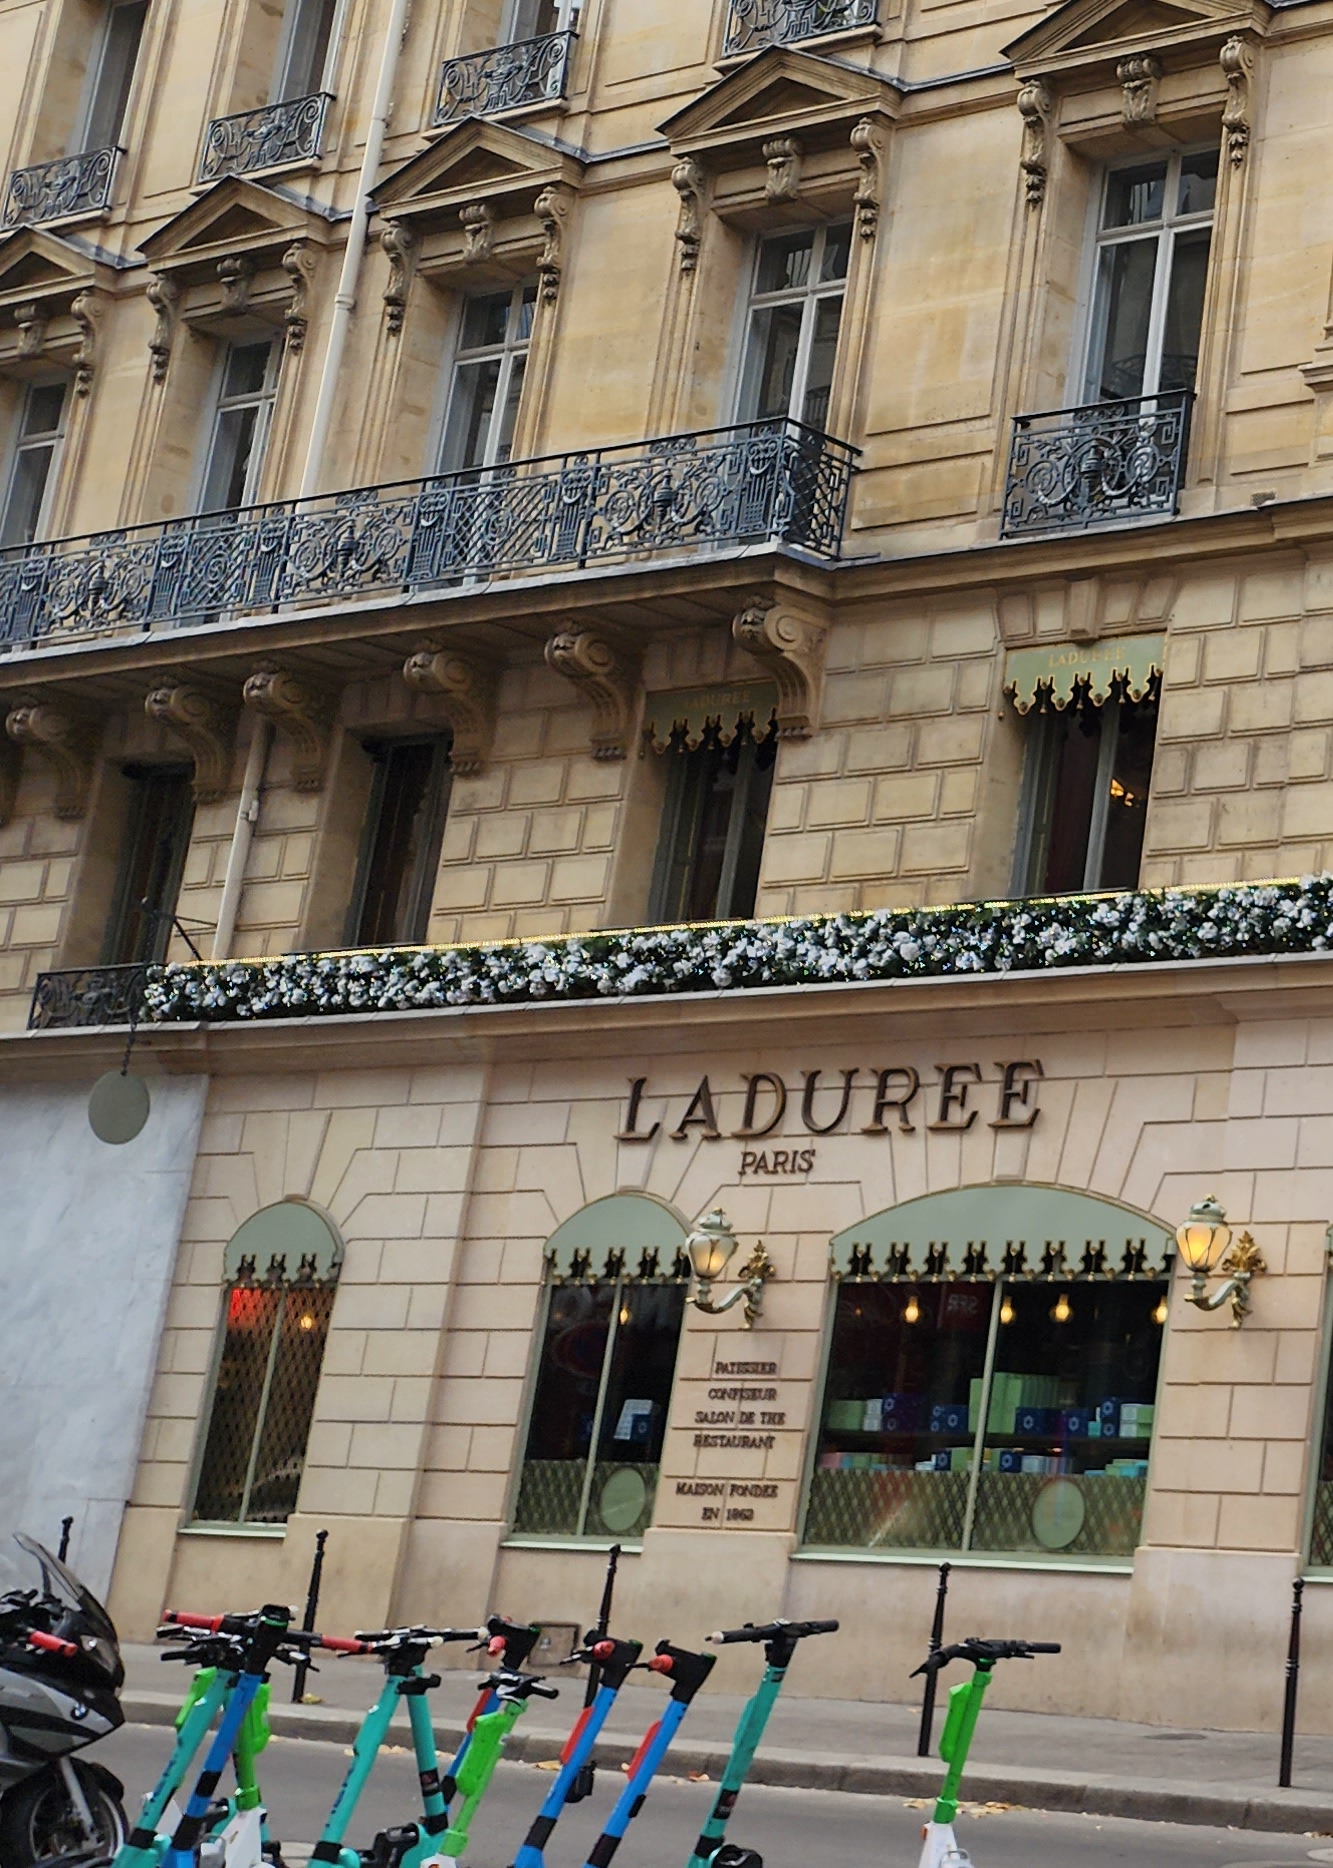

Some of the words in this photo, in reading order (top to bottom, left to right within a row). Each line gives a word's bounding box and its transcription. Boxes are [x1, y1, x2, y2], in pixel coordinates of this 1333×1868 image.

[613, 1059, 1045, 1142] LADUREE
[738, 1149, 816, 1175] PARIS
[715, 1362, 777, 1374] PATISSIER
[708, 1388, 777, 1400] CONFISEUR
[694, 1411, 735, 1424] SALON
[739, 1412, 756, 1424] DE
[693, 1434, 776, 1449] RESTAURANT
[676, 1482, 725, 1496] MAISON
[701, 1507, 720, 1520] EN
